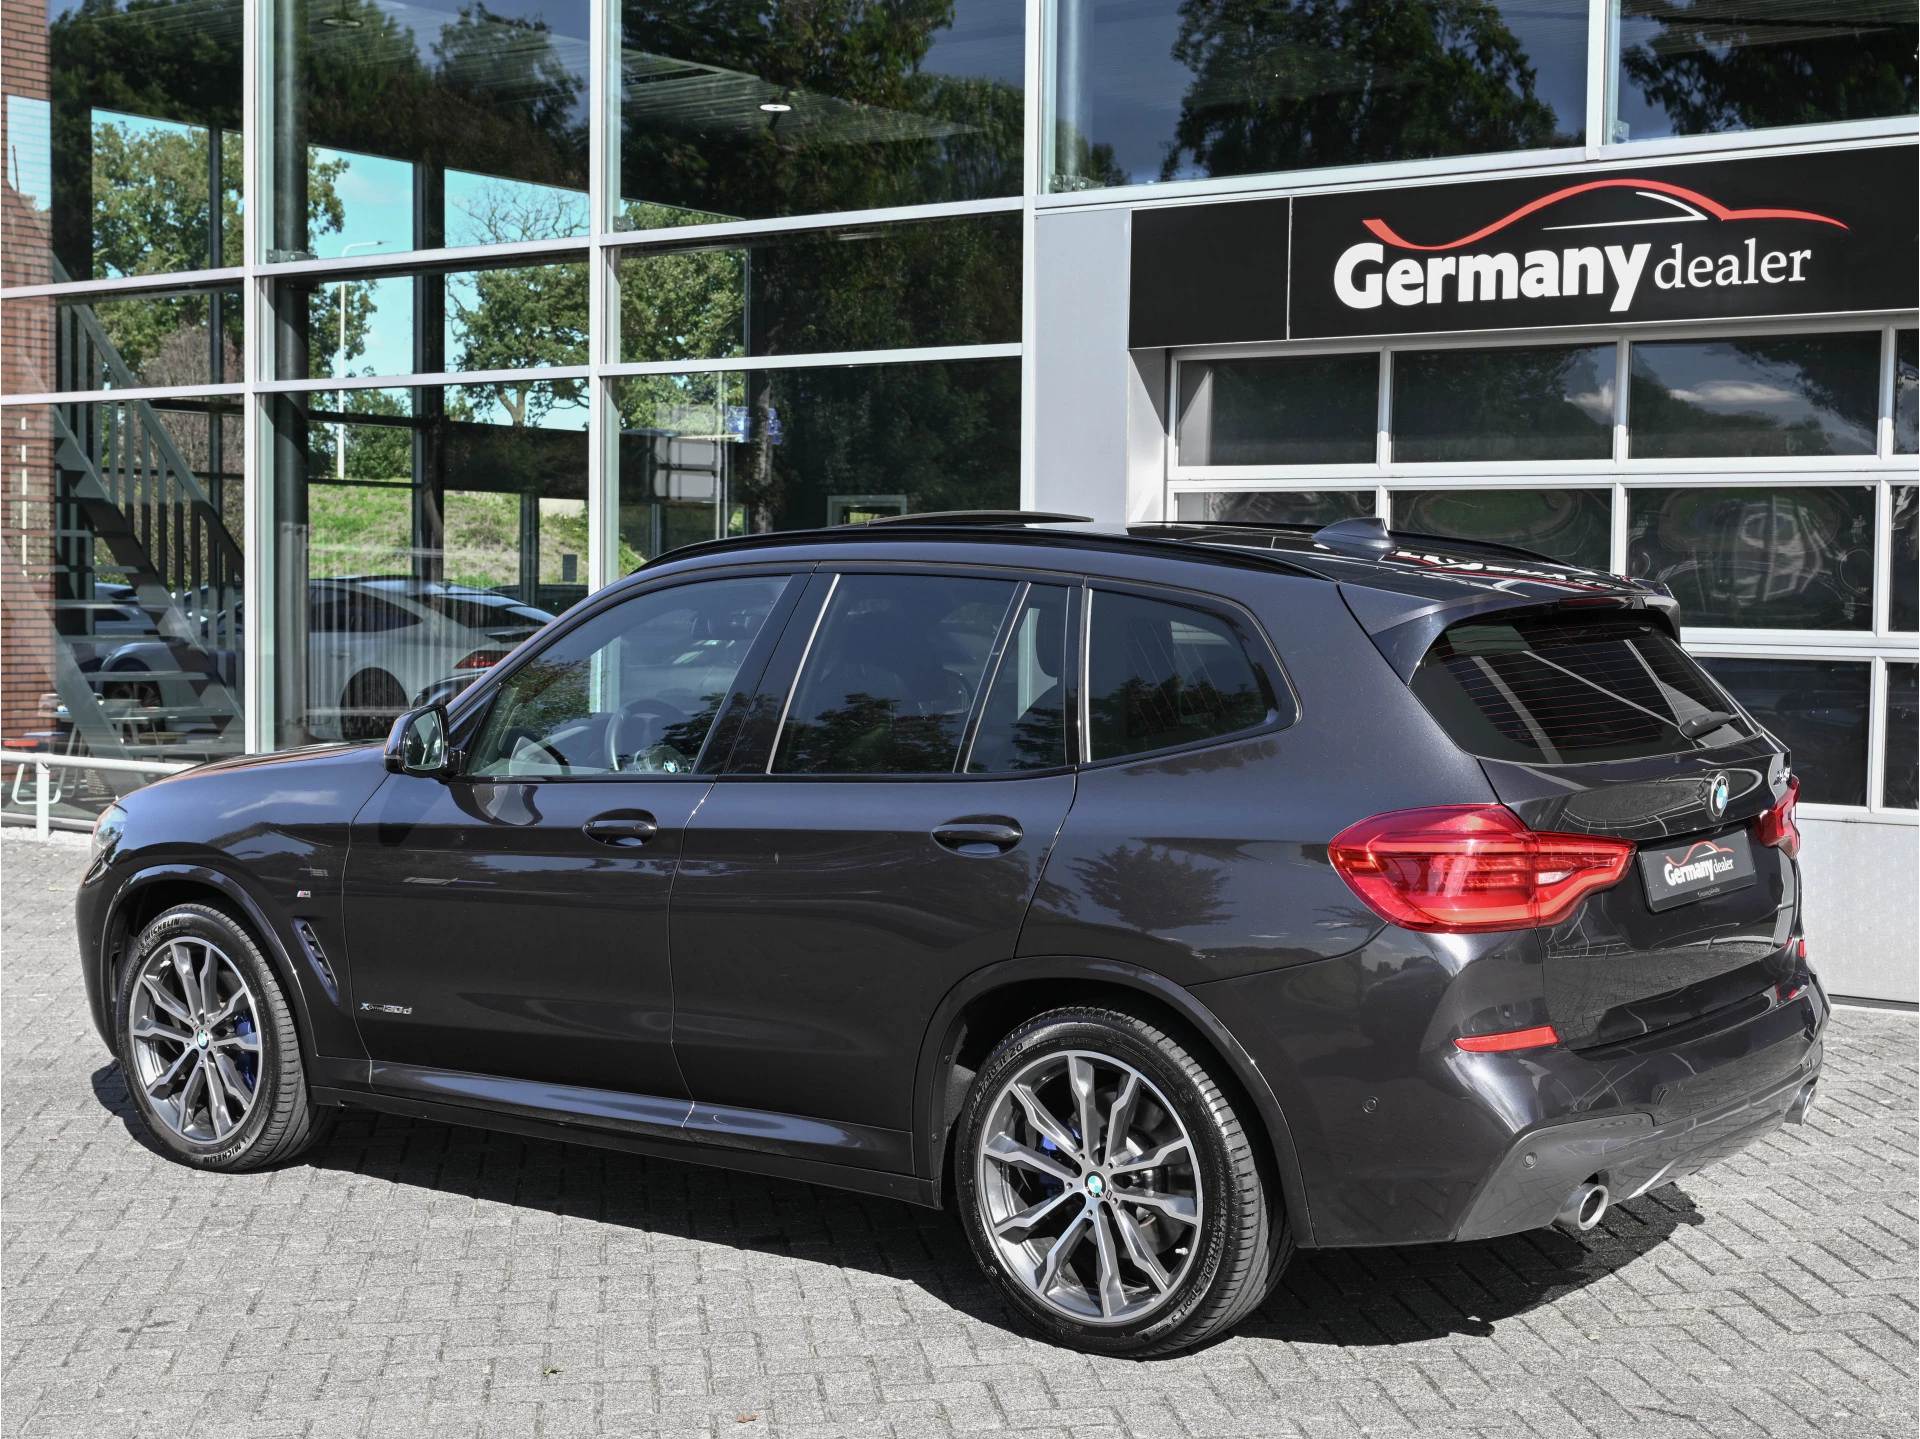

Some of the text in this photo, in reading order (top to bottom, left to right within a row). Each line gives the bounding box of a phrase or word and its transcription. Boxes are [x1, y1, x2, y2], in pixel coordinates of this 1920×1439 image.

[1334, 238, 1812, 313] Germany dealer
[1664, 857, 1734, 886] Germany dealer
[145, 919, 180, 942] MICHELIN
[203, 1142, 241, 1164] MICHELIN
